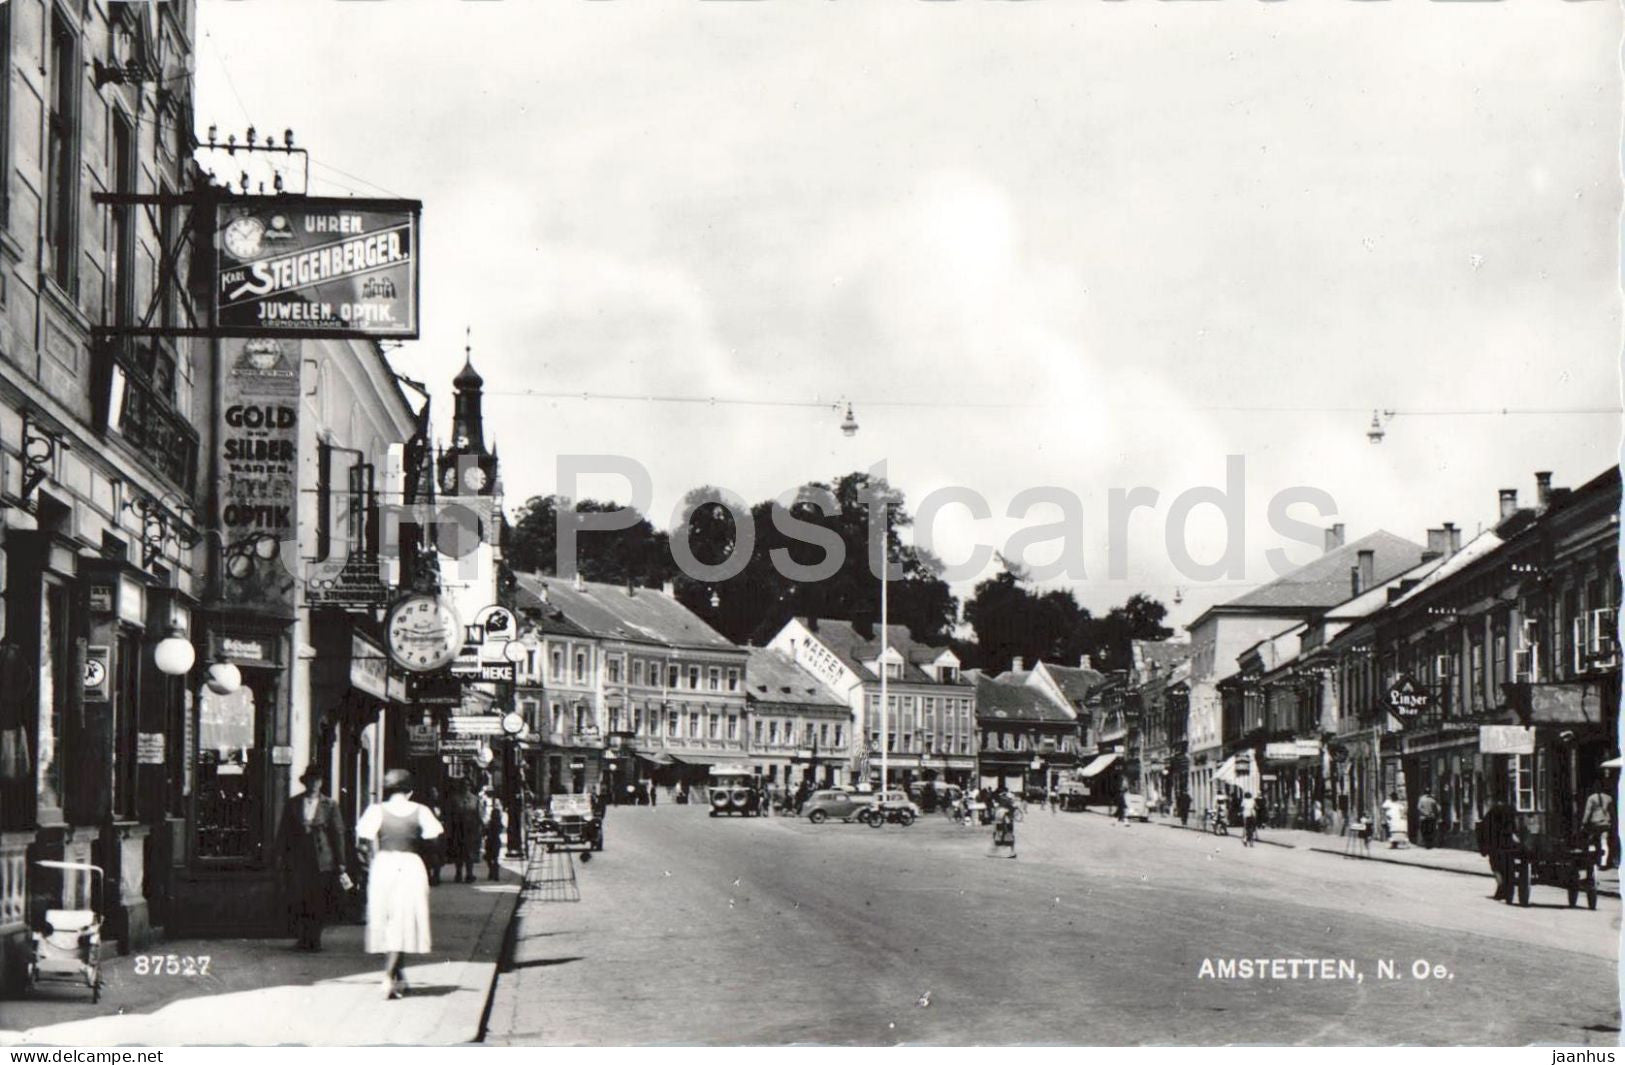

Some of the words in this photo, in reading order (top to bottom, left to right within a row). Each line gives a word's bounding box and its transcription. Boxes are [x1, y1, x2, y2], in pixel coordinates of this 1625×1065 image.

[230, 232, 409, 300] STEIGENBERGER.
[340, 302, 397, 321] OPTIK.
[225, 405, 297, 429] GOLD
[223, 438, 297, 461] SILBER
[229, 463, 293, 474] WAREN.
[223, 503, 291, 528] OPTIK
[1390, 689, 1428, 707] Linzer
